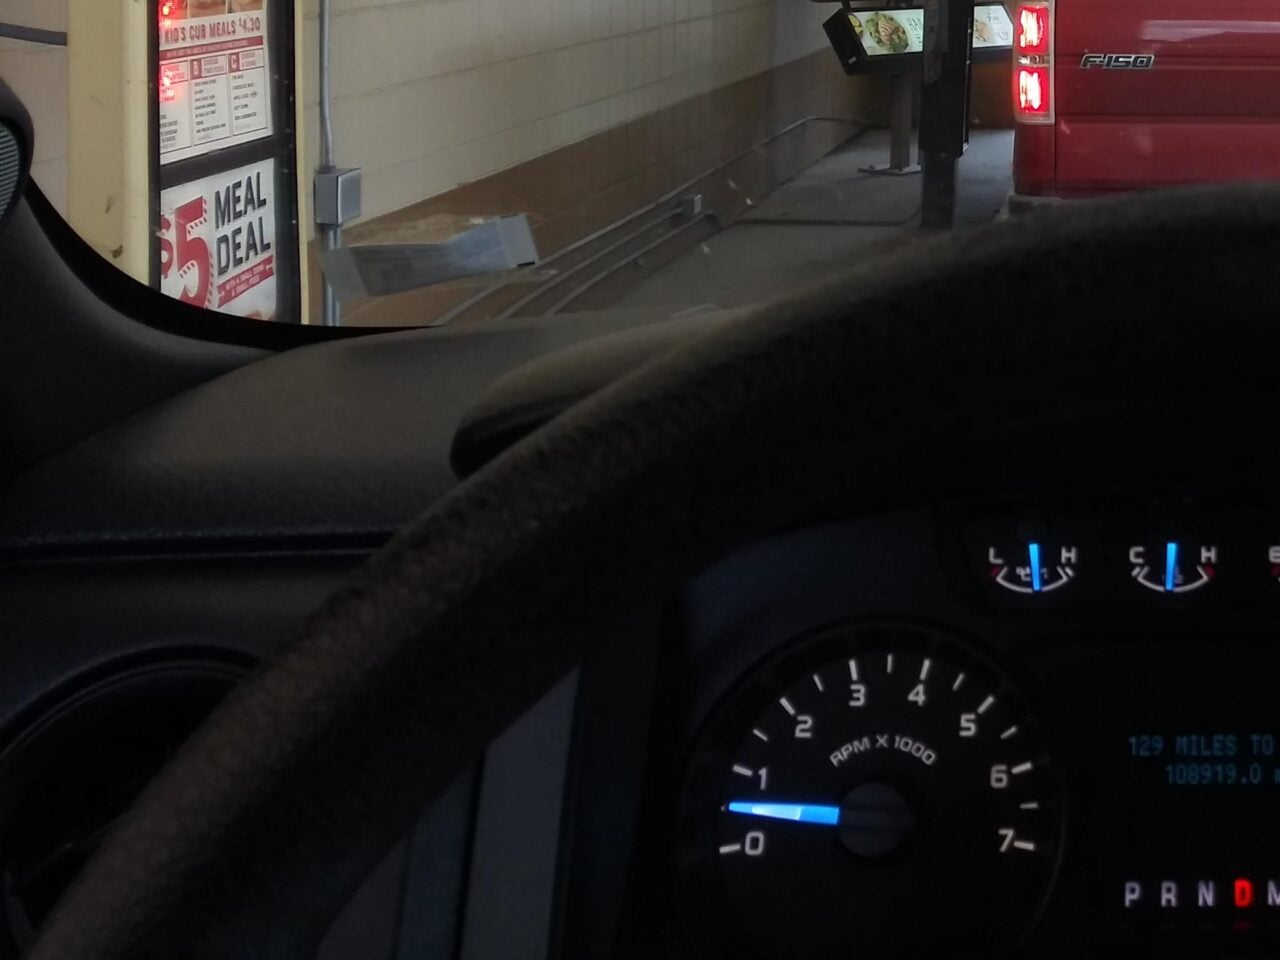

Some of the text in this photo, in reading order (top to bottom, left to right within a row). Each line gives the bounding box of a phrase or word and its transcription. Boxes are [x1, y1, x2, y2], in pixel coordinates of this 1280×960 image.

[164, 26, 186, 43] KID'S
[189, 24, 206, 40] CUB
[209, 20, 236, 38] MEALS
[1081, 54, 1155, 69] F-150
[215, 172, 266, 229] MEAL
[217, 217, 271, 276] DEAL
[990, 547, 1002, 563] L
[1062, 547, 1076, 563] H
[1130, 547, 1143, 563] C
[1202, 547, 1216, 563] H
[849, 684, 866, 706] 3
[908, 684, 925, 706] 4
[795, 716, 812, 738] 2
[959, 714, 976, 736] 5
[830, 734, 937, 767] RPM X 1000
[1129, 735, 1164, 756] 129
[1176, 734, 1238, 756] MILES
[1250, 734, 1274, 756] TO
[758, 768, 767, 790] 1
[990, 765, 1008, 788] 6
[1165, 764, 1262, 784] 108919.0
[744, 832, 764, 855] 0
[998, 828, 1014, 852] 7
[1124, 882, 1141, 907] P
[1161, 880, 1178, 907] R
[1198, 880, 1215, 906] N
[1233, 878, 1253, 908] D
